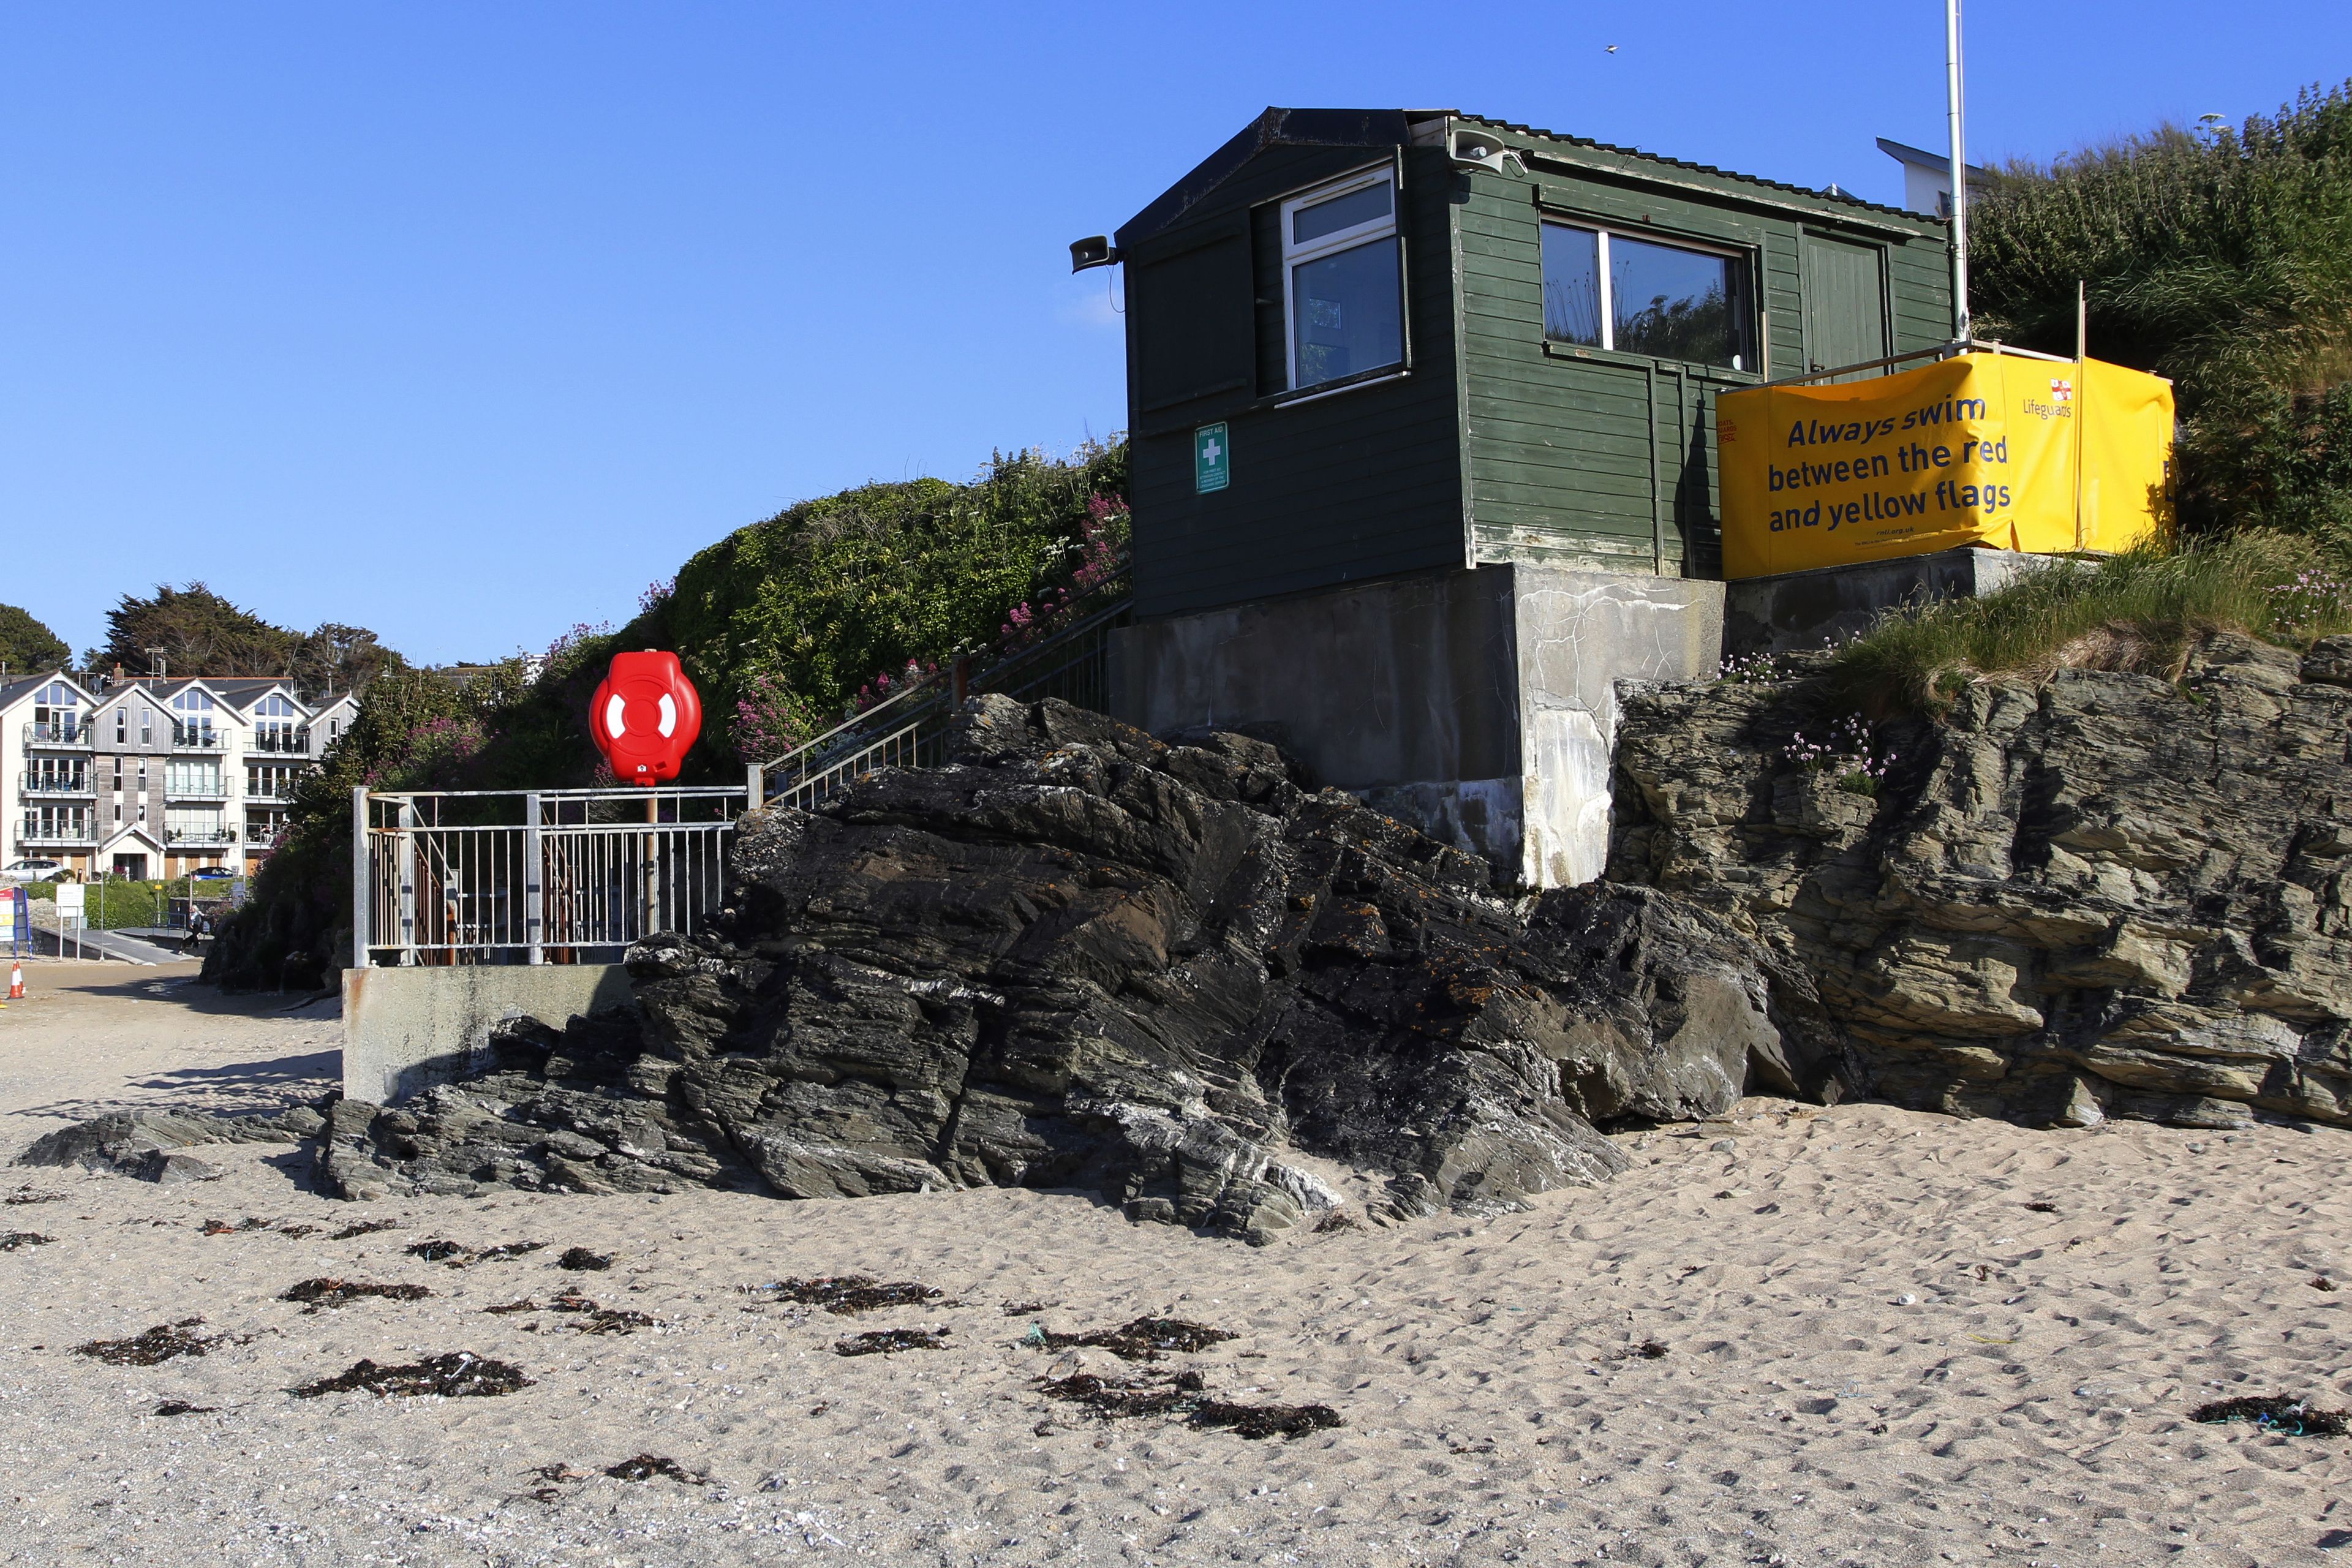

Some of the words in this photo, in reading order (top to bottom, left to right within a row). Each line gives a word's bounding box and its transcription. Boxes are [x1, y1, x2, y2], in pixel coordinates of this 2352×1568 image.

[1787, 419, 1896, 448] Always
[1901, 394, 1986, 430] swim
[2023, 399, 2071, 420] Lifeguards
[1199, 428, 1213, 437] FIRST
[1769, 452, 1889, 492] between
[1898, 442, 1951, 472] the
[1964, 435, 2008, 464] red
[1770, 500, 1820, 532] and
[1826, 491, 1927, 531] yellow
[1936, 479, 2011, 514] flags
[1876, 526, 1915, 536] rnli.org.uk
